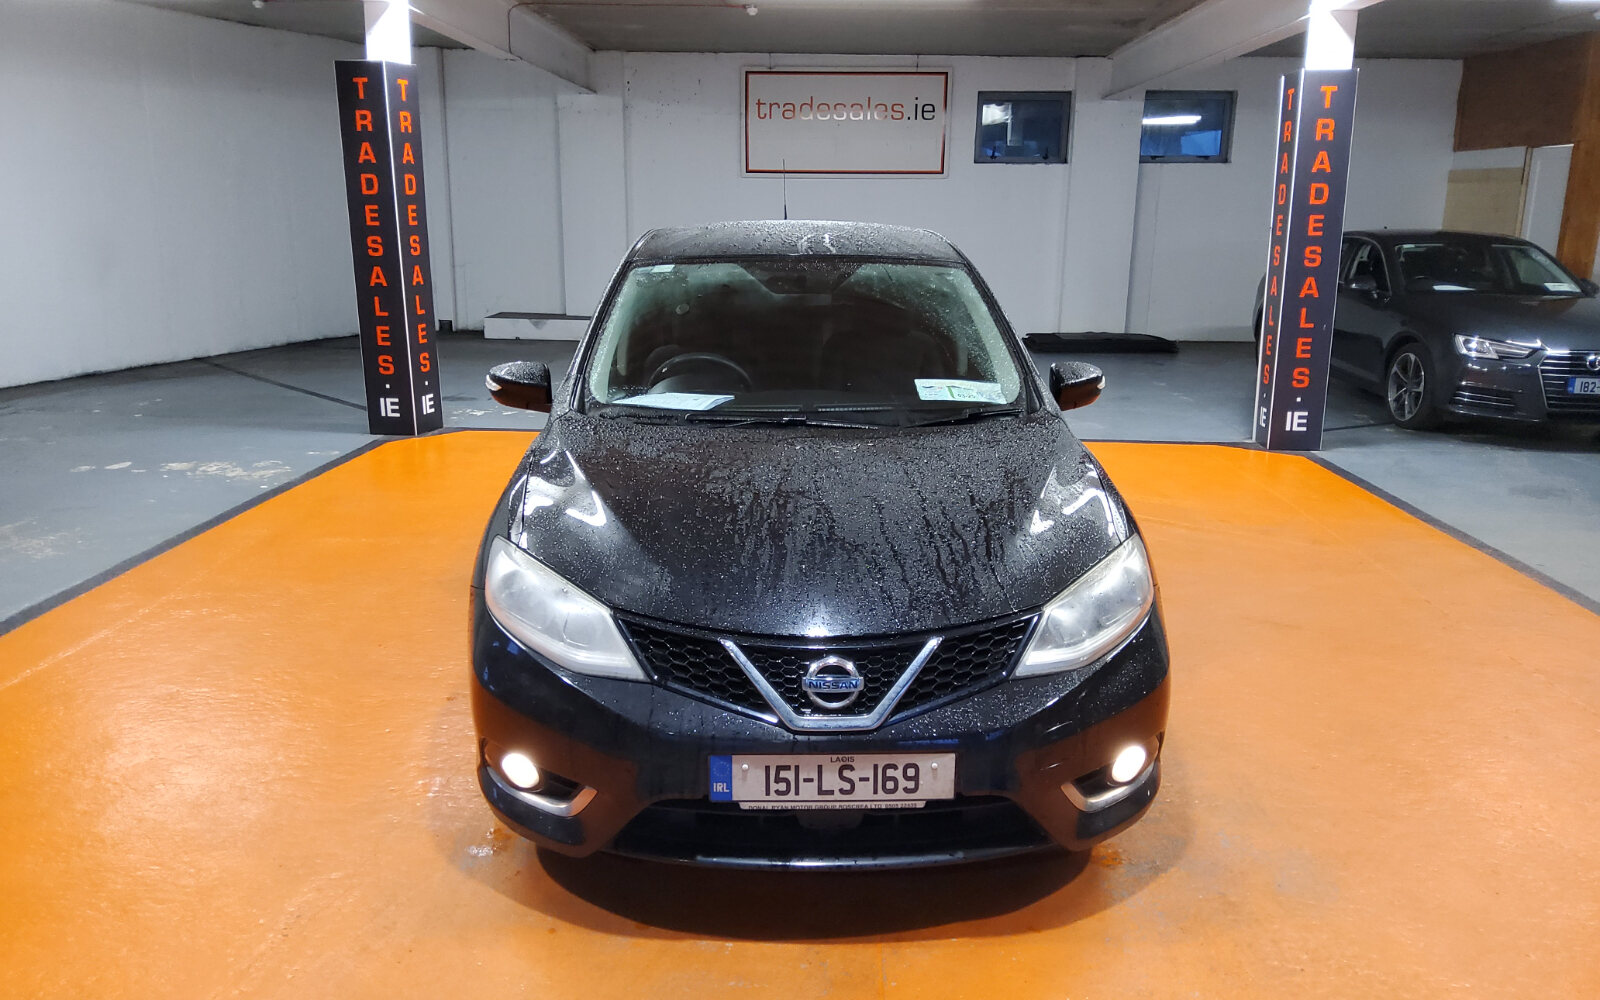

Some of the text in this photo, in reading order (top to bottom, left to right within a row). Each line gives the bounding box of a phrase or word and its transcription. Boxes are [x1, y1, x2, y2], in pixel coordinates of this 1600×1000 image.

[755, 96, 936, 121] tradesales.ie
[808, 681, 859, 690] NISSAN
[713, 782, 730, 792] IRL
[764, 763, 920, 797] 151-LS-169
